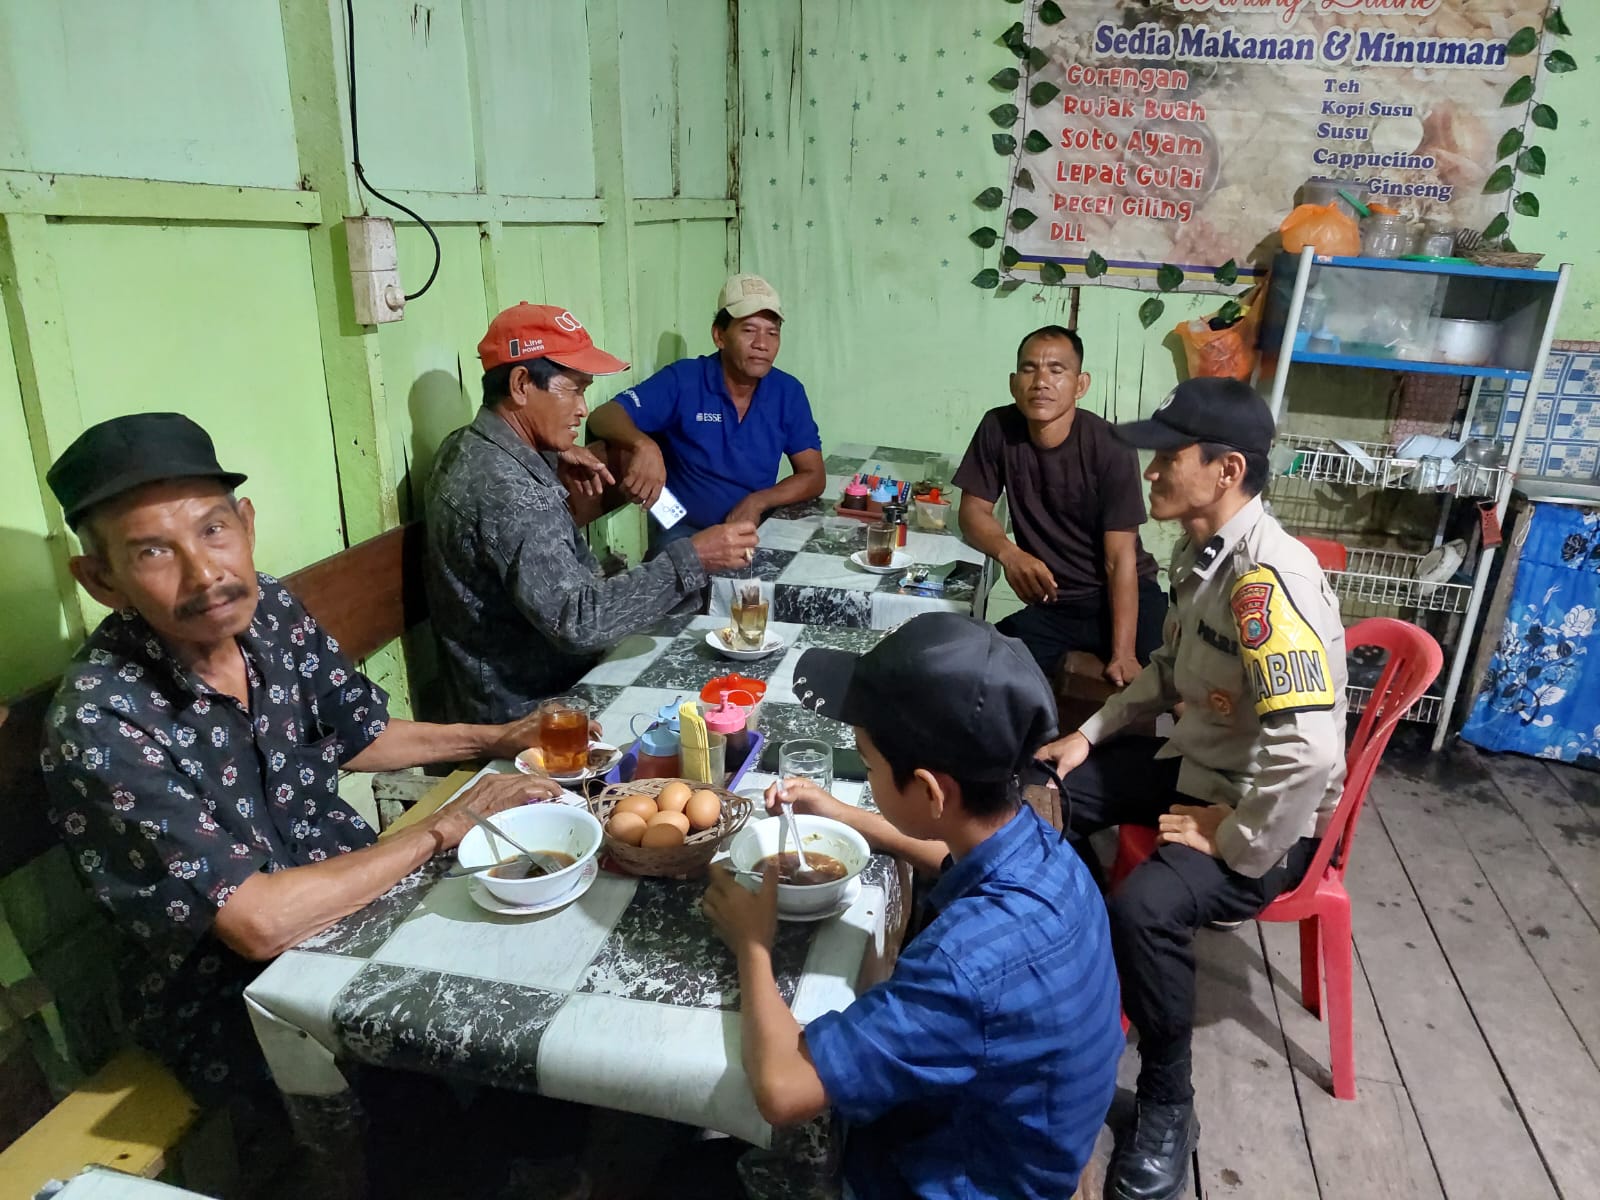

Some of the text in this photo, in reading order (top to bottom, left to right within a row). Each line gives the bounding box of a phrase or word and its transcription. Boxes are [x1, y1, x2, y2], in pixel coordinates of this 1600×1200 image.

[1095, 25, 1507, 66] Sedia Makanan & Minuman
[1066, 65, 1188, 91] Gorengan
[1324, 79, 1360, 93] Teh
[1063, 95, 1206, 121] Rujak Buah
[1321, 101, 1413, 118] Kopi Susu
[1317, 122, 1368, 139] Susu
[1127, 130, 1204, 156] Ayam
[1313, 148, 1435, 169] Cappuciino
[1056, 160, 1204, 190] Lepat Gulai
[1368, 179, 1452, 202] Ginseng
[1122, 197, 1193, 223] Giling
[1050, 222, 1086, 242] DLL
[703, 413, 722, 422] ESSE
[1247, 650, 1326, 702] ABIN
